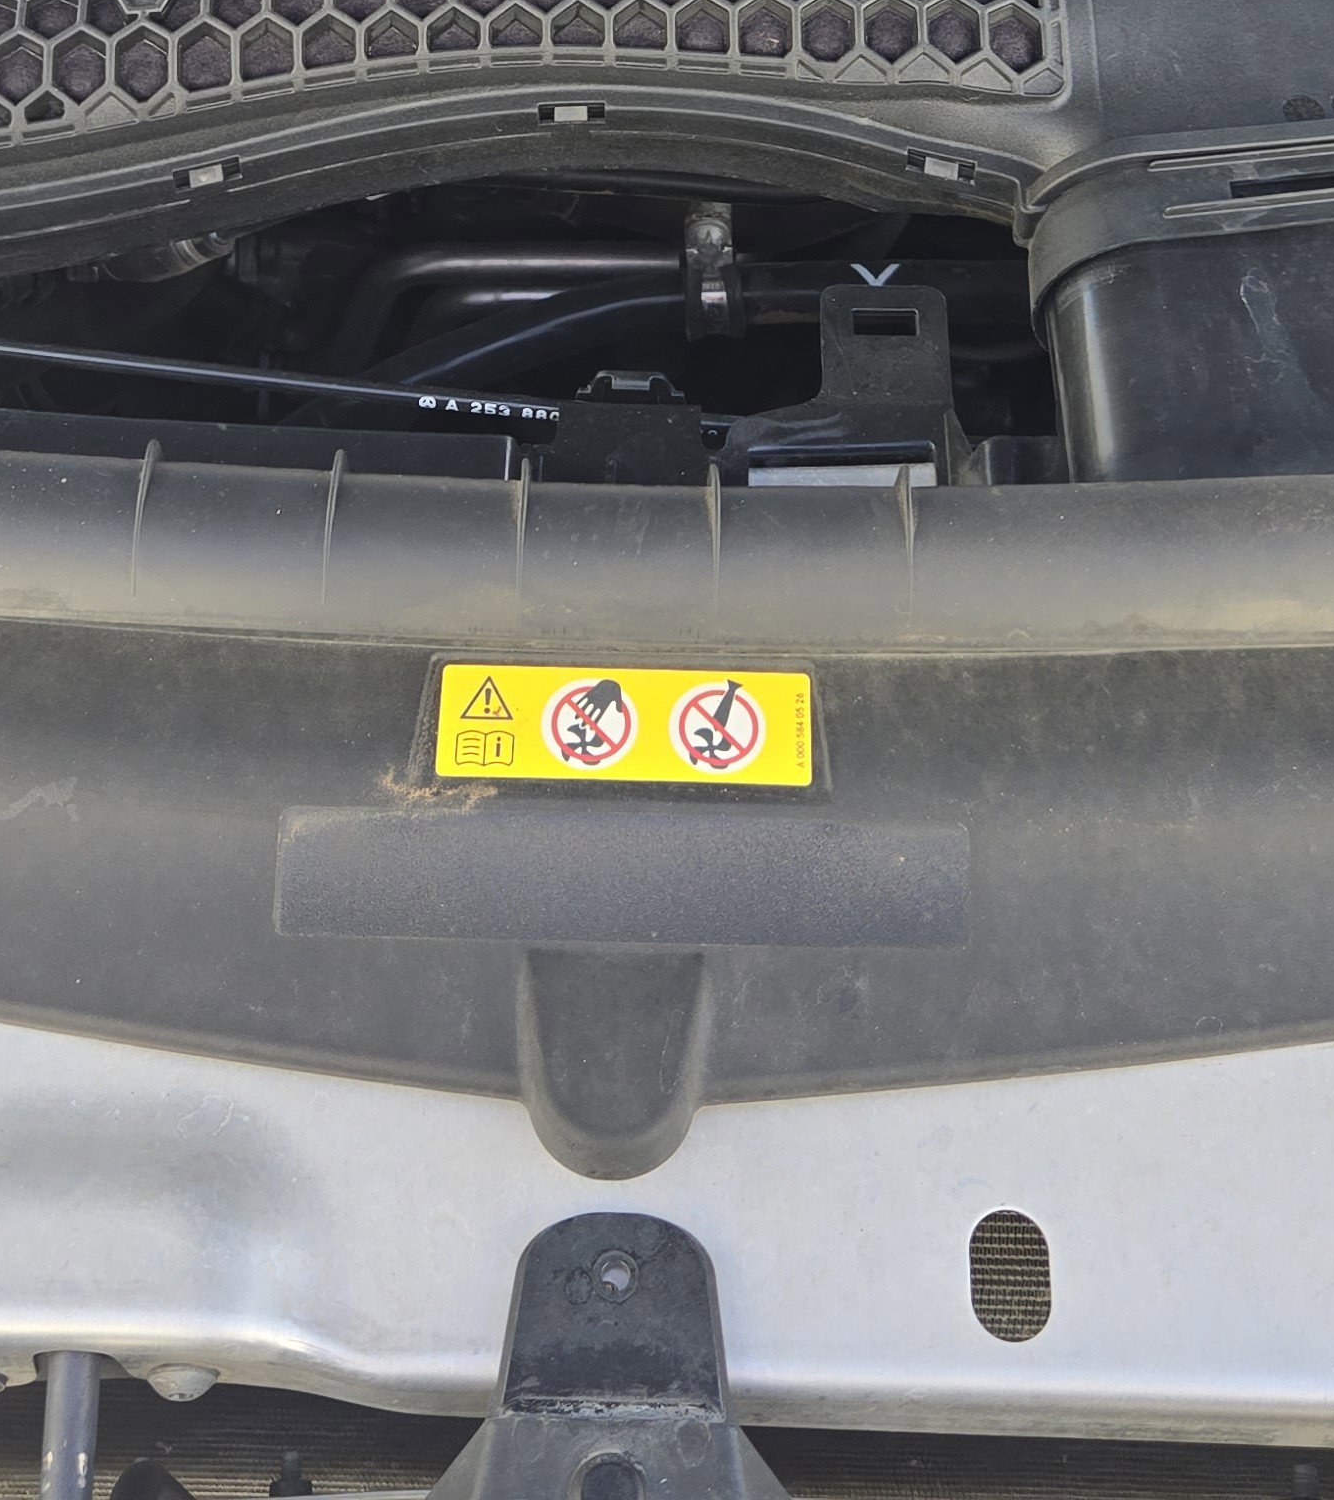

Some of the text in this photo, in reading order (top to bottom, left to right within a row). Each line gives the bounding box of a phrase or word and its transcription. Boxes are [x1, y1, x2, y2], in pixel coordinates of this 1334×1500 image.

[445, 399, 459, 412] A
[470, 401, 511, 417] 253
[795, 692, 805, 769] A 000 584 05 26
